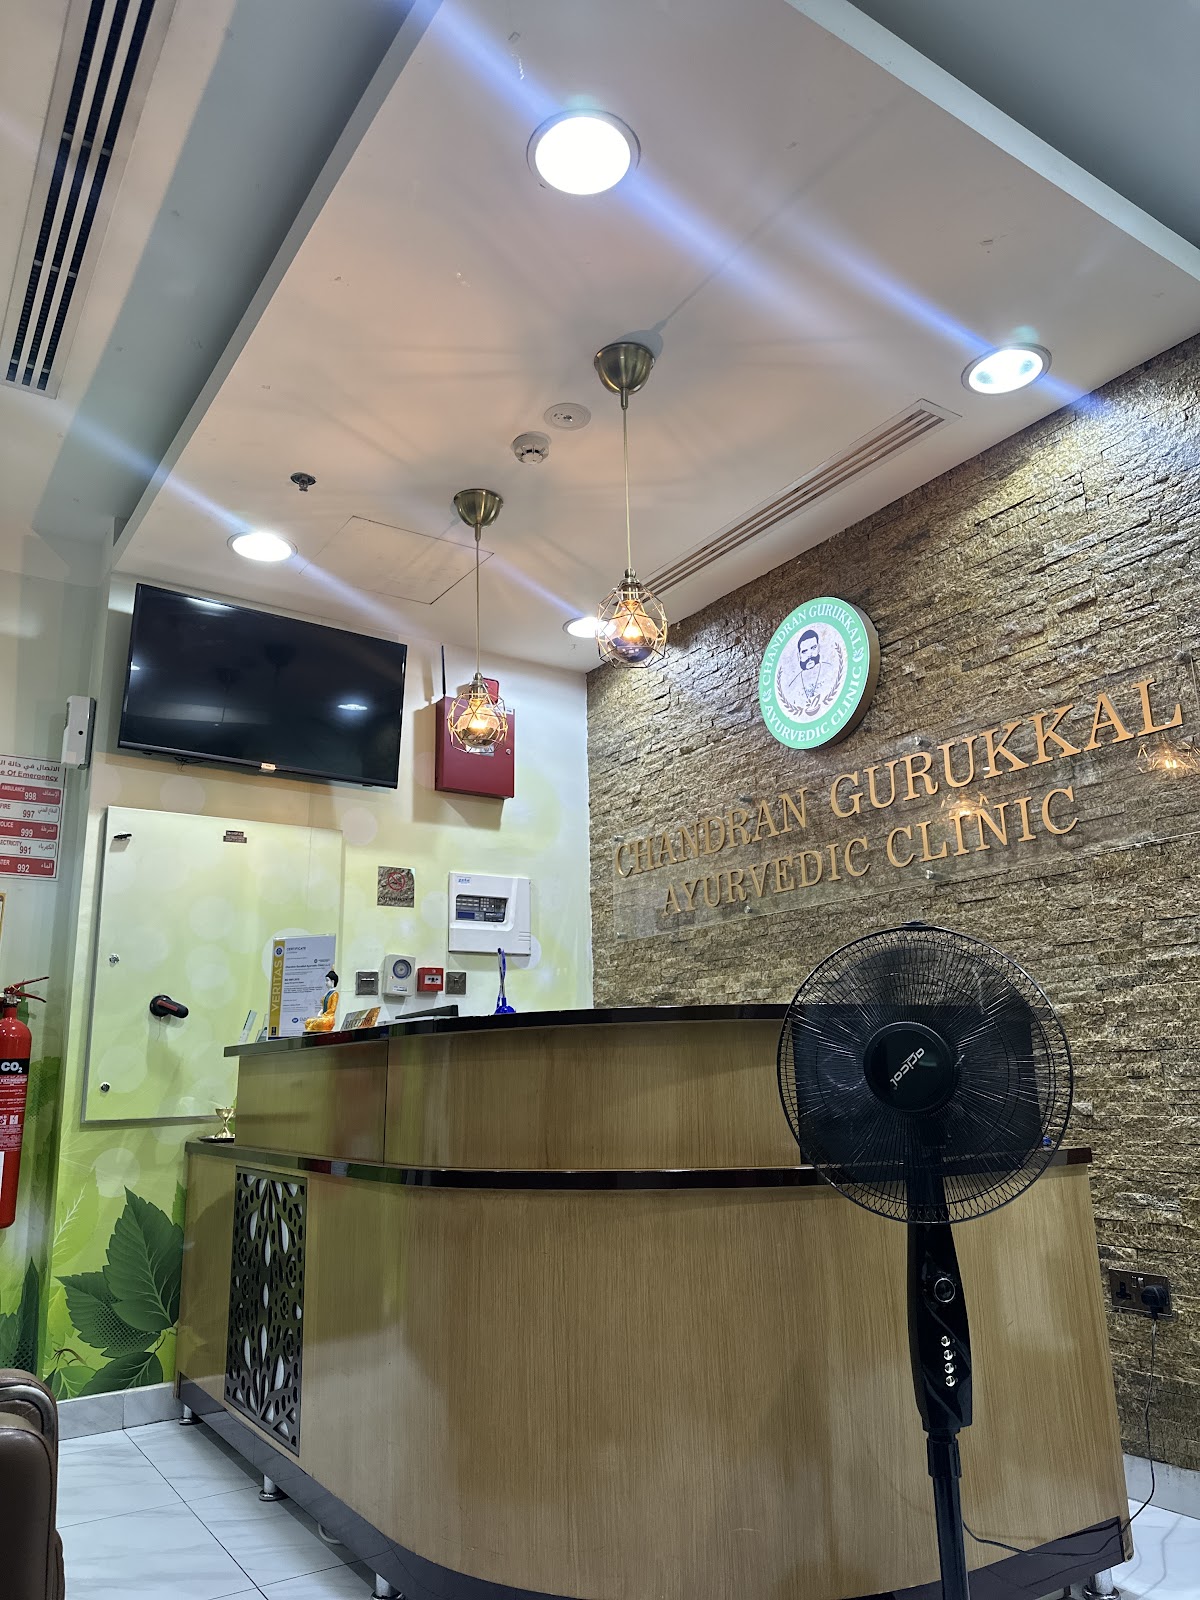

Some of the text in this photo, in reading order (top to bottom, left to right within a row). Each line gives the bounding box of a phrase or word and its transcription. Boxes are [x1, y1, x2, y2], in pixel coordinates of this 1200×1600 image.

[763, 603, 861, 686] CHANDRAN GURUKKAL
[764, 666, 862, 742] AYURVEDIC CLINIC
[17, 770, 59, 782] Emergency
[614, 678, 1183, 878] CHANDRAN GURUKKAL
[24, 792, 37, 800] 998
[22, 810, 35, 818] 997
[20, 828, 33, 837] 999
[20, 846, 31, 854] 991
[661, 785, 1079, 918] AYURVEDIC CLINIC
[17, 864, 30, 872] 992
[271, 960, 283, 1012] VERITAS
